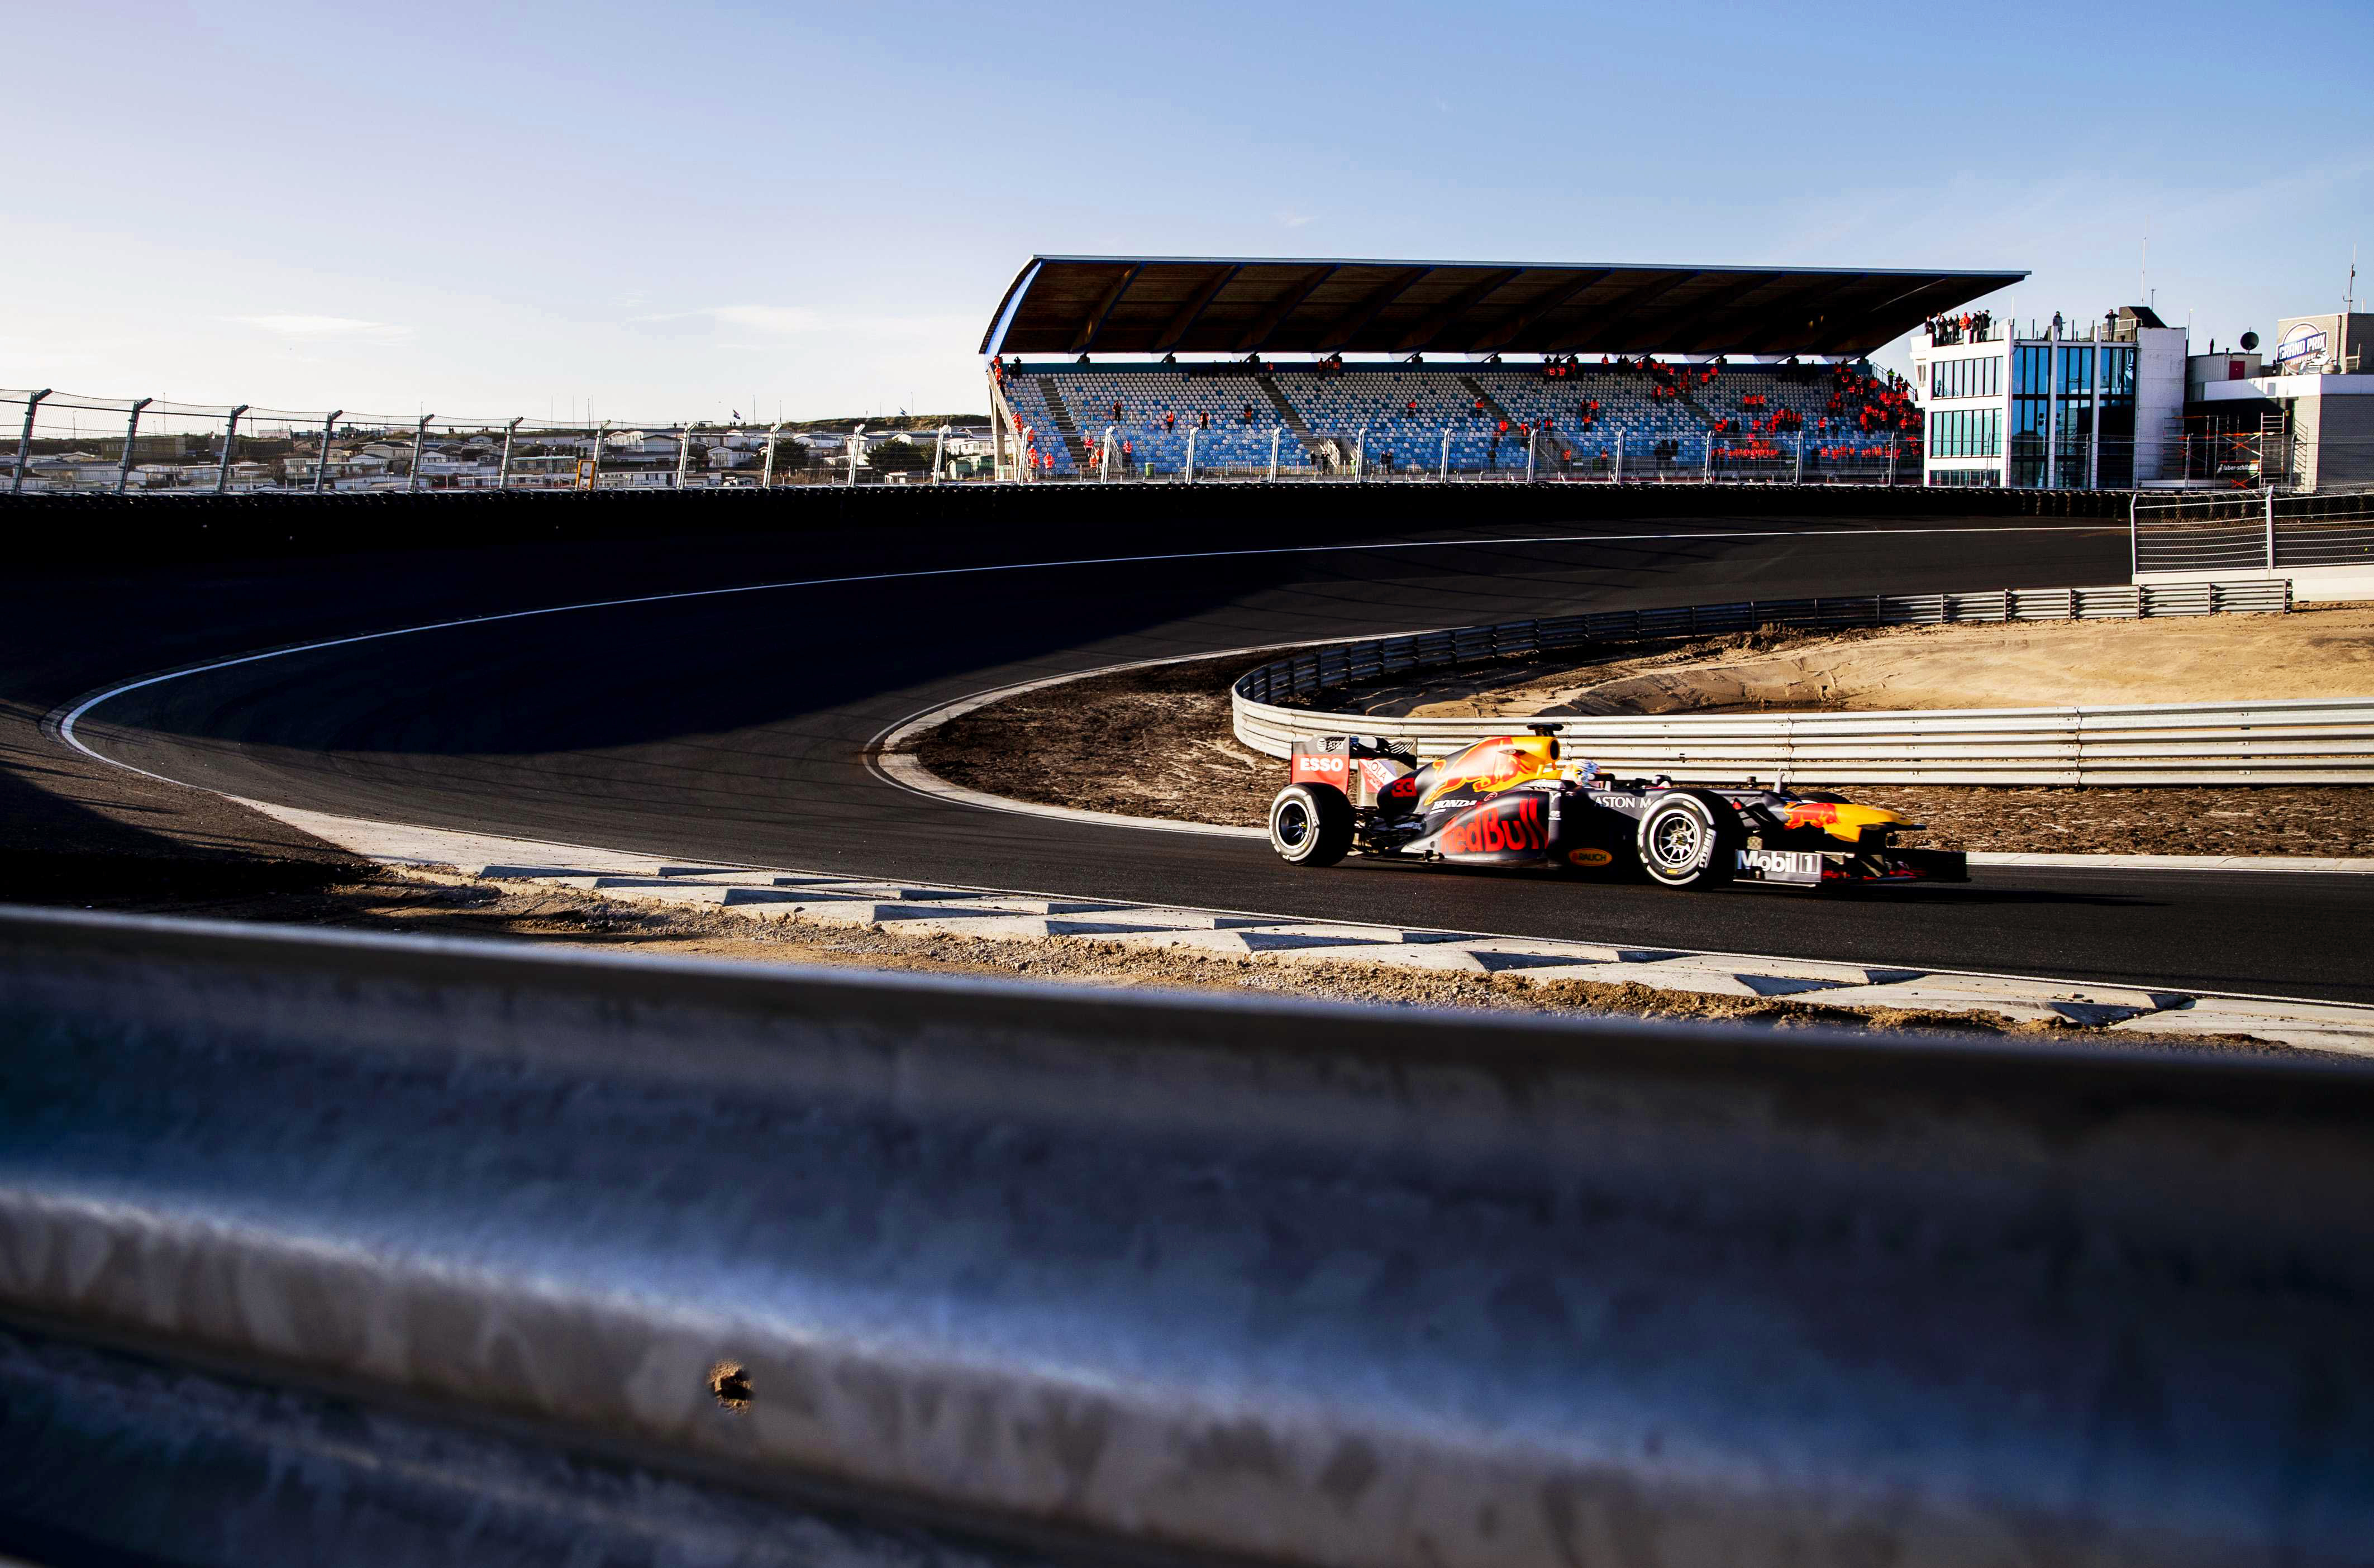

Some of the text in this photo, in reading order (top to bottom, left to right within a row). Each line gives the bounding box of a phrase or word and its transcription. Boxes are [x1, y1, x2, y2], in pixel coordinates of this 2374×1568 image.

[2279, 340, 2305, 359] GRAND
[2307, 333, 2325, 352] PRIX
[1300, 757, 1343, 771] ESSO
[1391, 778, 1417, 797] 33
[1431, 799, 1477, 810] HONDA
[1595, 796, 1636, 808] ASTON
[1578, 852, 1606, 861] RAUCH
[1737, 850, 1797, 873] Mobil
